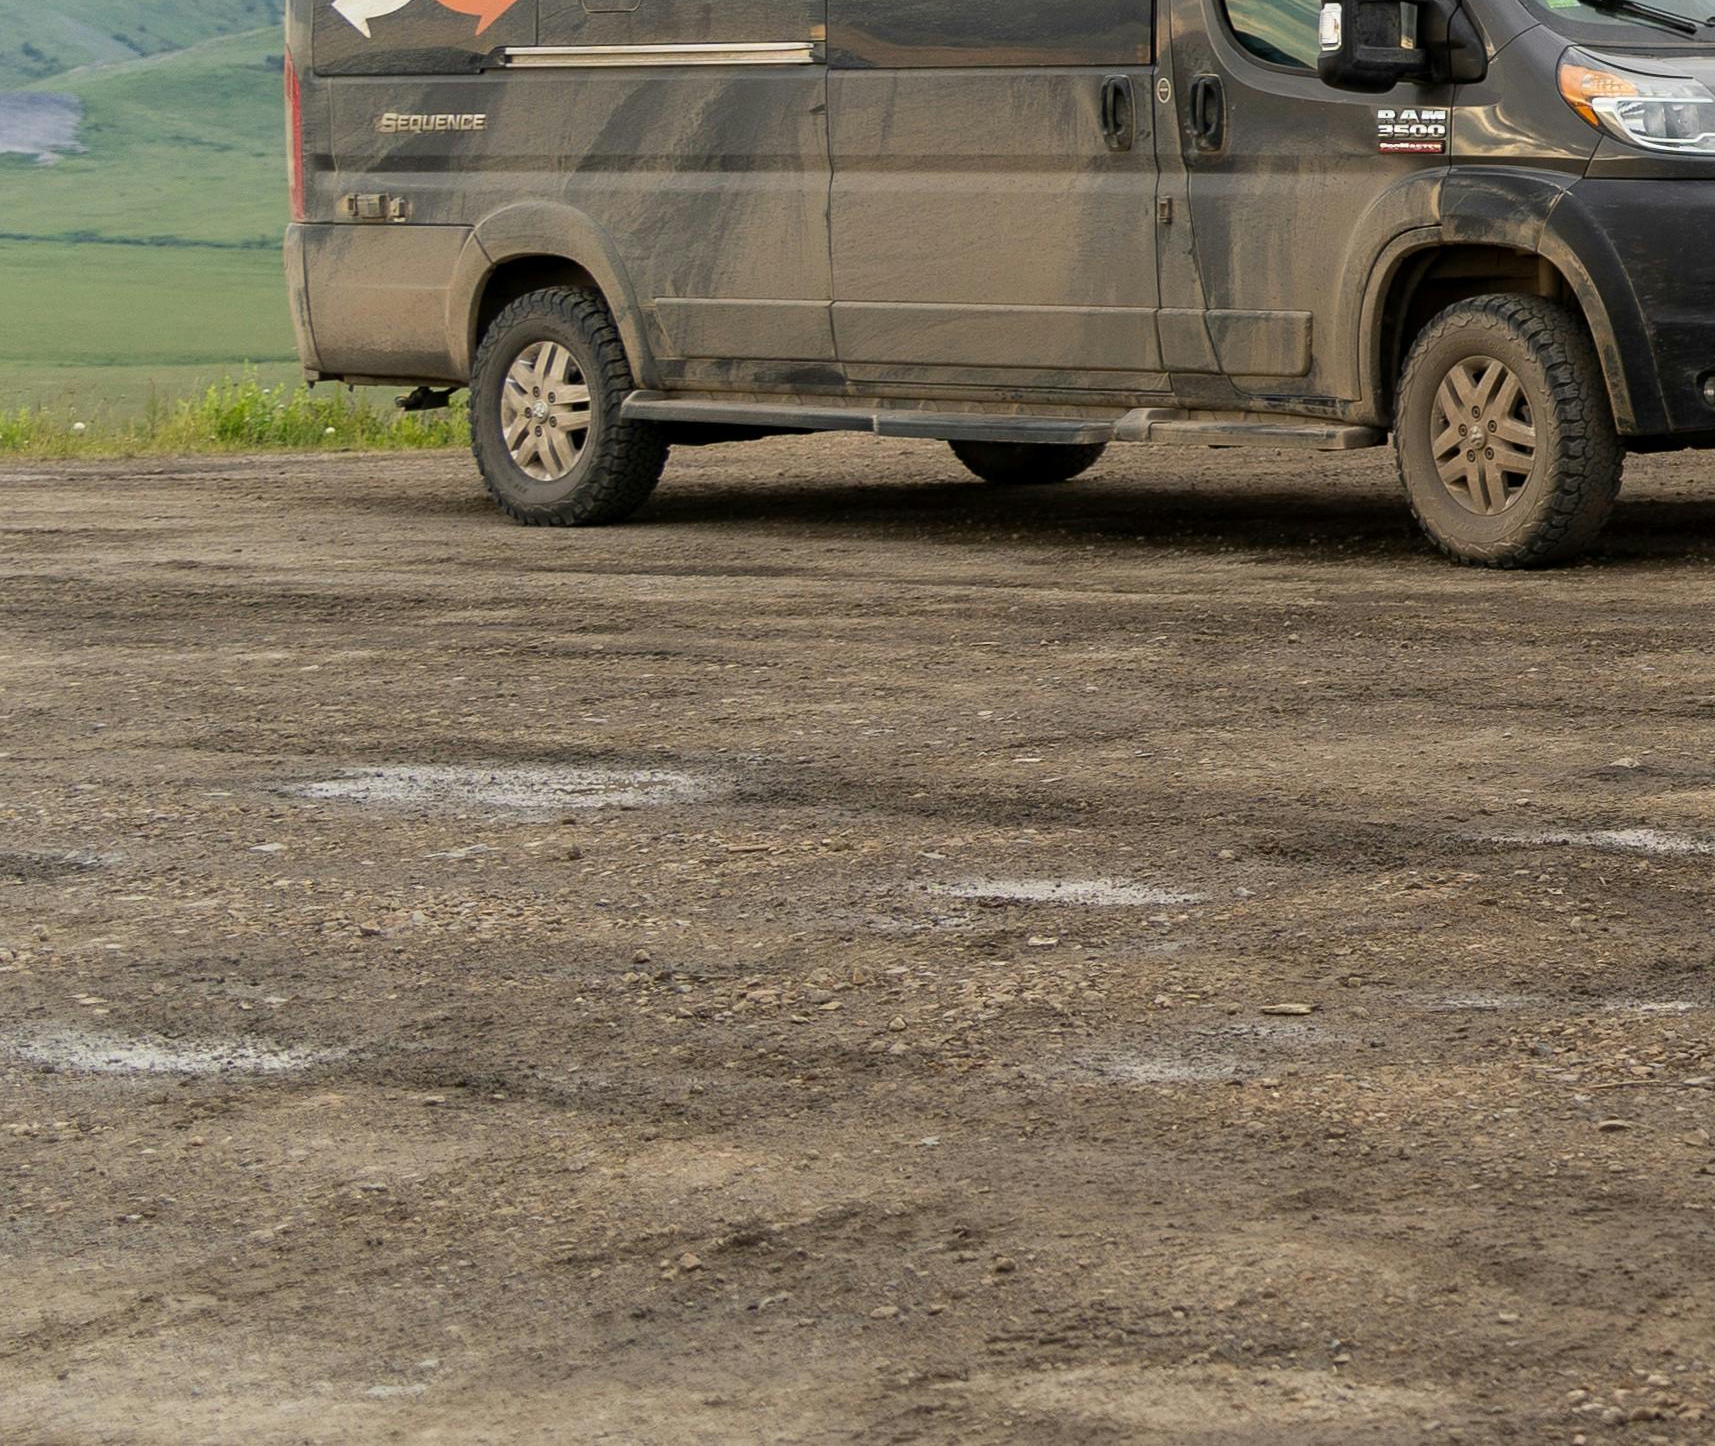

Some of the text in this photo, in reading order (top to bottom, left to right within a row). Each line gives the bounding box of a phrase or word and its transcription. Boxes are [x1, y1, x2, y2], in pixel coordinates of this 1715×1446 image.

[379, 112, 487, 133] SEQUENCE
[1377, 109, 1446, 123] RAM
[1377, 124, 1446, 138] 3500
